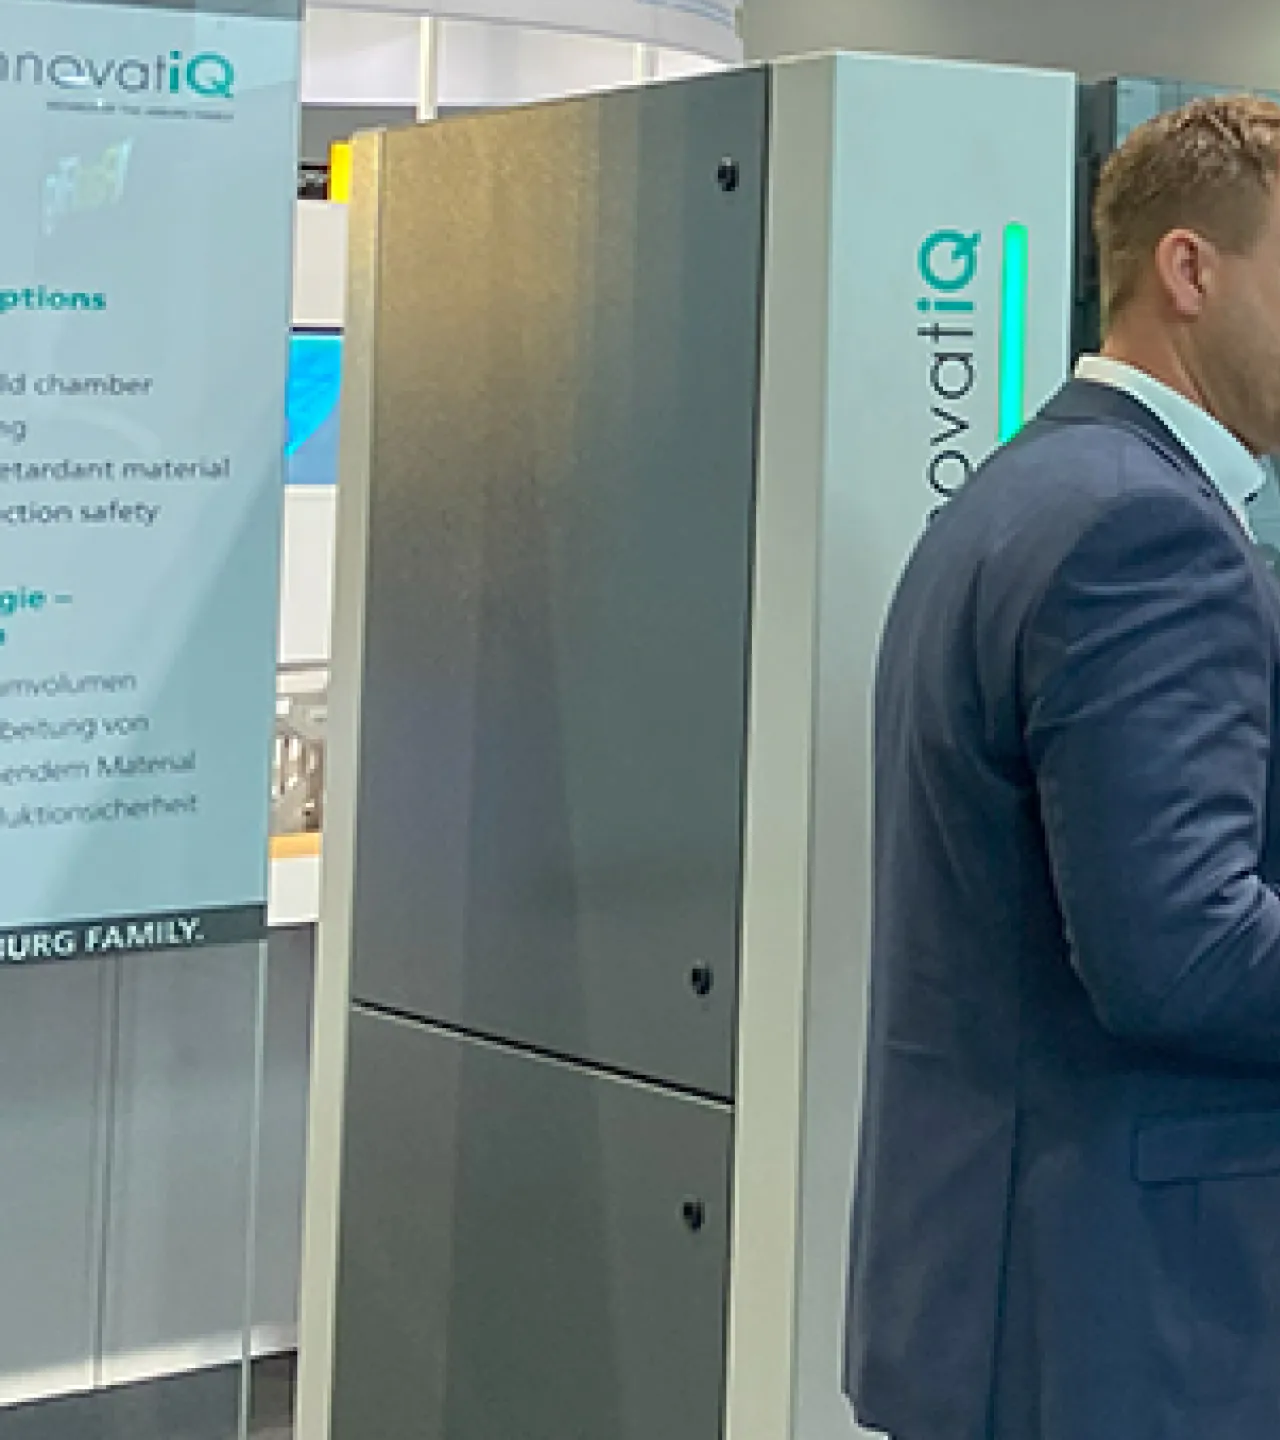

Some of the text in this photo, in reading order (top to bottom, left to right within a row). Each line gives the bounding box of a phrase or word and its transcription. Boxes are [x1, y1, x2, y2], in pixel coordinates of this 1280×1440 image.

[33, 373, 154, 396] chamber
[916, 228, 982, 522] ovatiQ
[122, 455, 231, 481] material
[0, 498, 161, 528] ction safety
[101, 716, 150, 736] von
[97, 749, 197, 777] Material
[0, 917, 205, 962] URG FAMILY.
